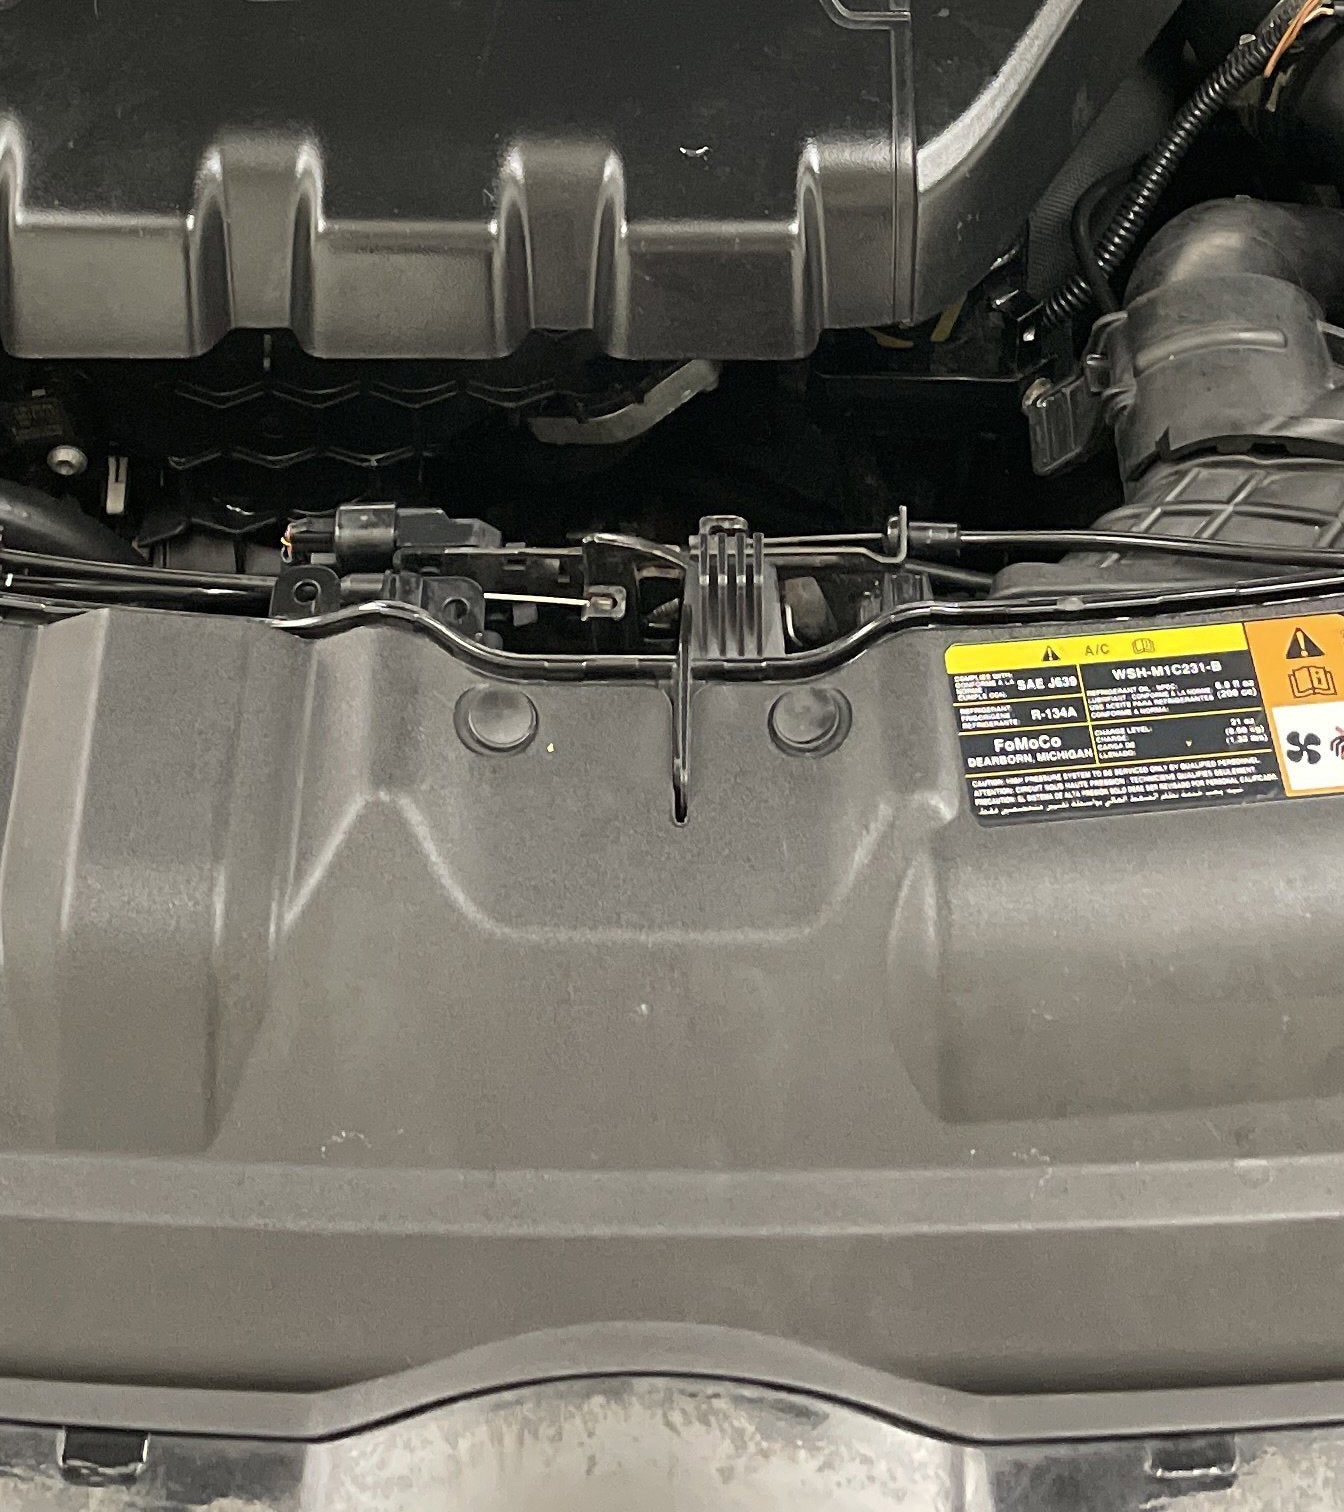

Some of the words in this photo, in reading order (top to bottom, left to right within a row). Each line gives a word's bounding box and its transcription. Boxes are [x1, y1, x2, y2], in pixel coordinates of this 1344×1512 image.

[1084, 643, 1110, 657] A/C
[1111, 660, 1222, 682] WSH-M1C231-B
[1017, 678, 1044, 690] SAE
[1047, 676, 1077, 687] J639
[1030, 706, 1077, 719] R-134A
[993, 734, 1061, 751] FoMoCo
[967, 753, 1035, 767] DEARBORN,
[1036, 748, 1092, 761] MICHIGAN
